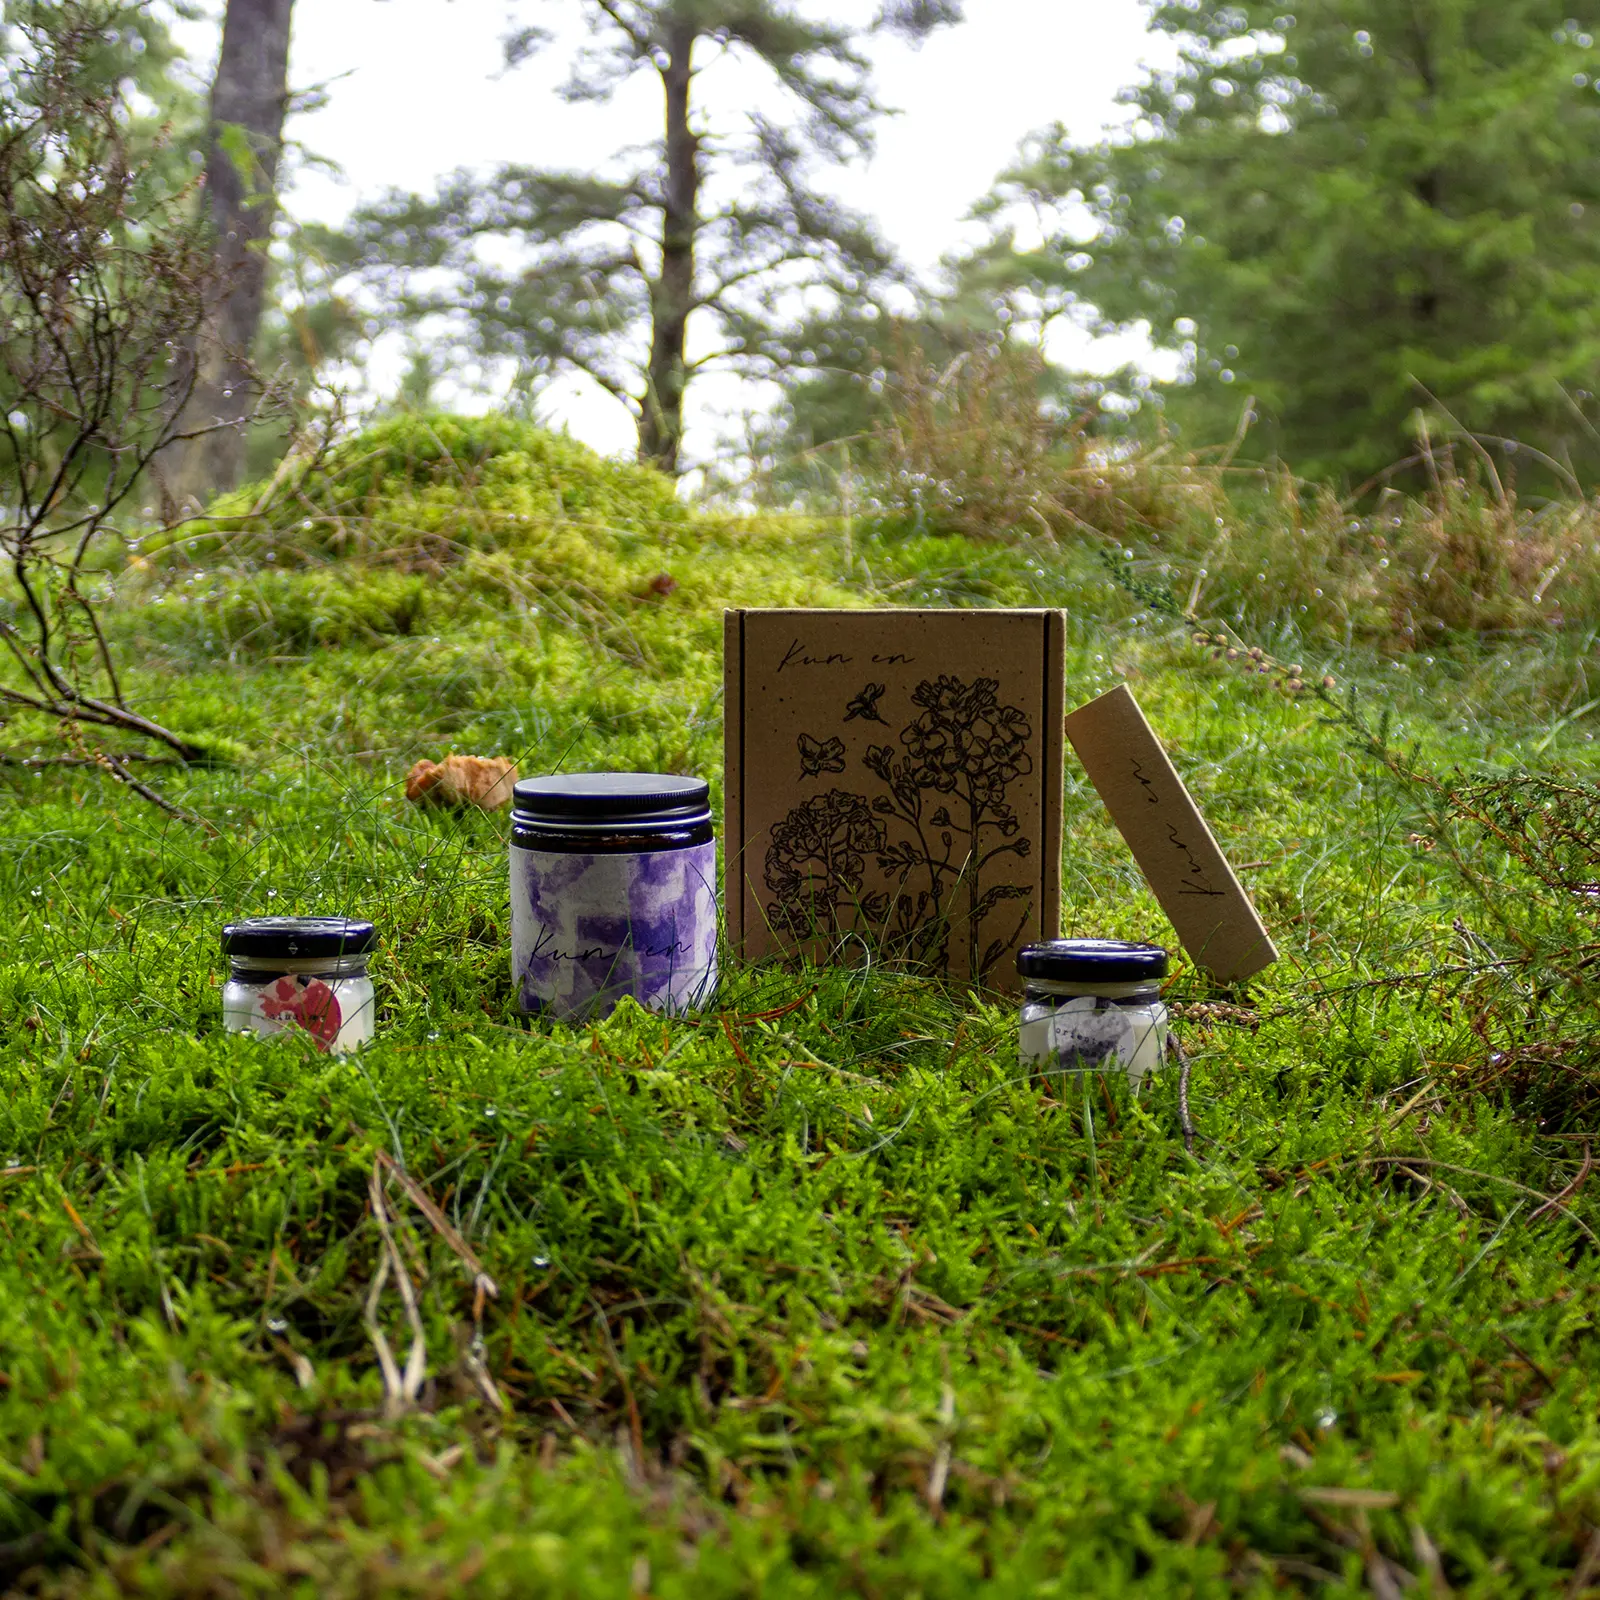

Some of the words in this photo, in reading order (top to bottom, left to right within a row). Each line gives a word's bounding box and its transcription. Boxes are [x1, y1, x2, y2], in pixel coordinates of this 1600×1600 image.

[777, 638, 853, 672] Kun
[871, 652, 915, 664] en
[1129, 758, 1159, 804] en
[1166, 822, 1226, 896] Kun
[528, 923, 618, 968] Kun
[645, 941, 692, 958] en
